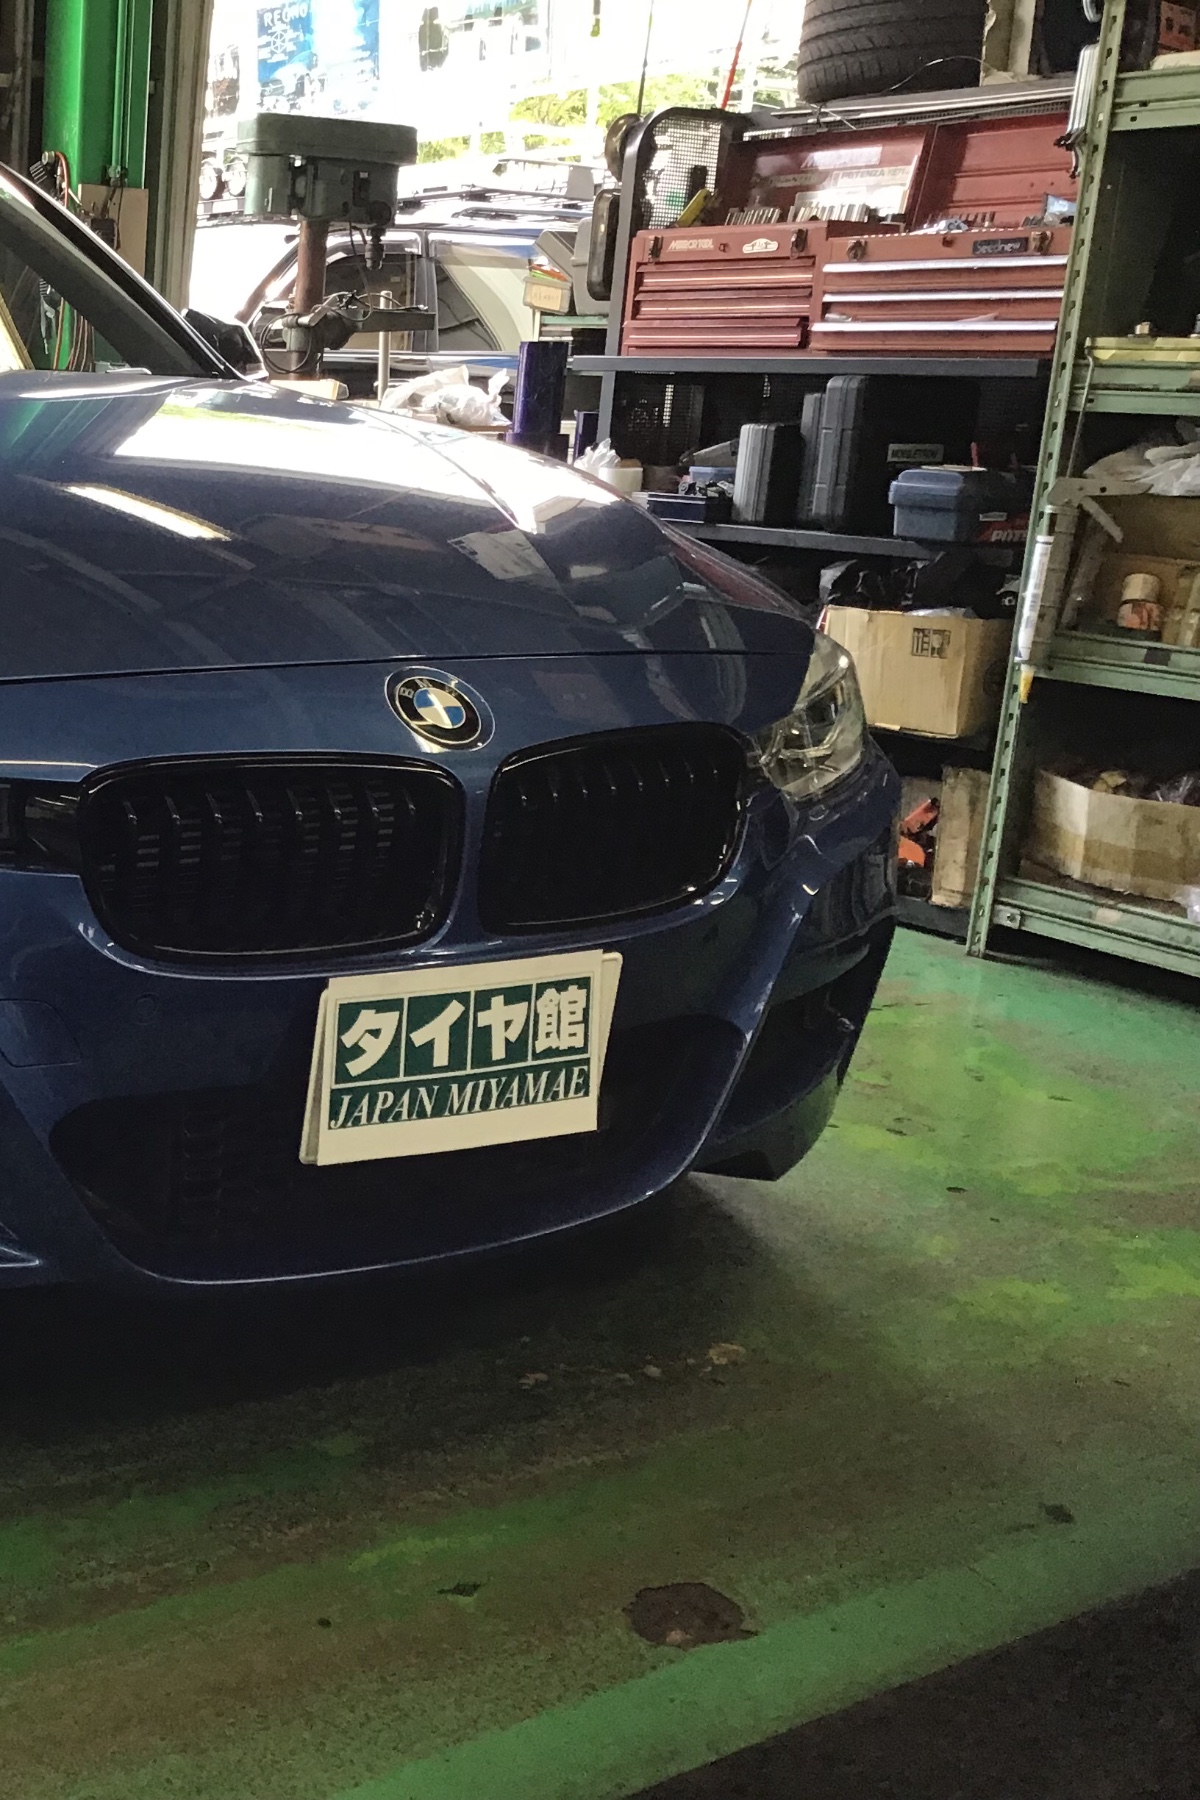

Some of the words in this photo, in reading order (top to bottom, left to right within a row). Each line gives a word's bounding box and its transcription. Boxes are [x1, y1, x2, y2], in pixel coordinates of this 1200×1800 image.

[399, 678, 458, 698] BMW
[340, 985, 587, 1077] タイヤ館
[330, 1085, 438, 1129] JAPAN
[448, 1065, 589, 1115] MIYAMAE
